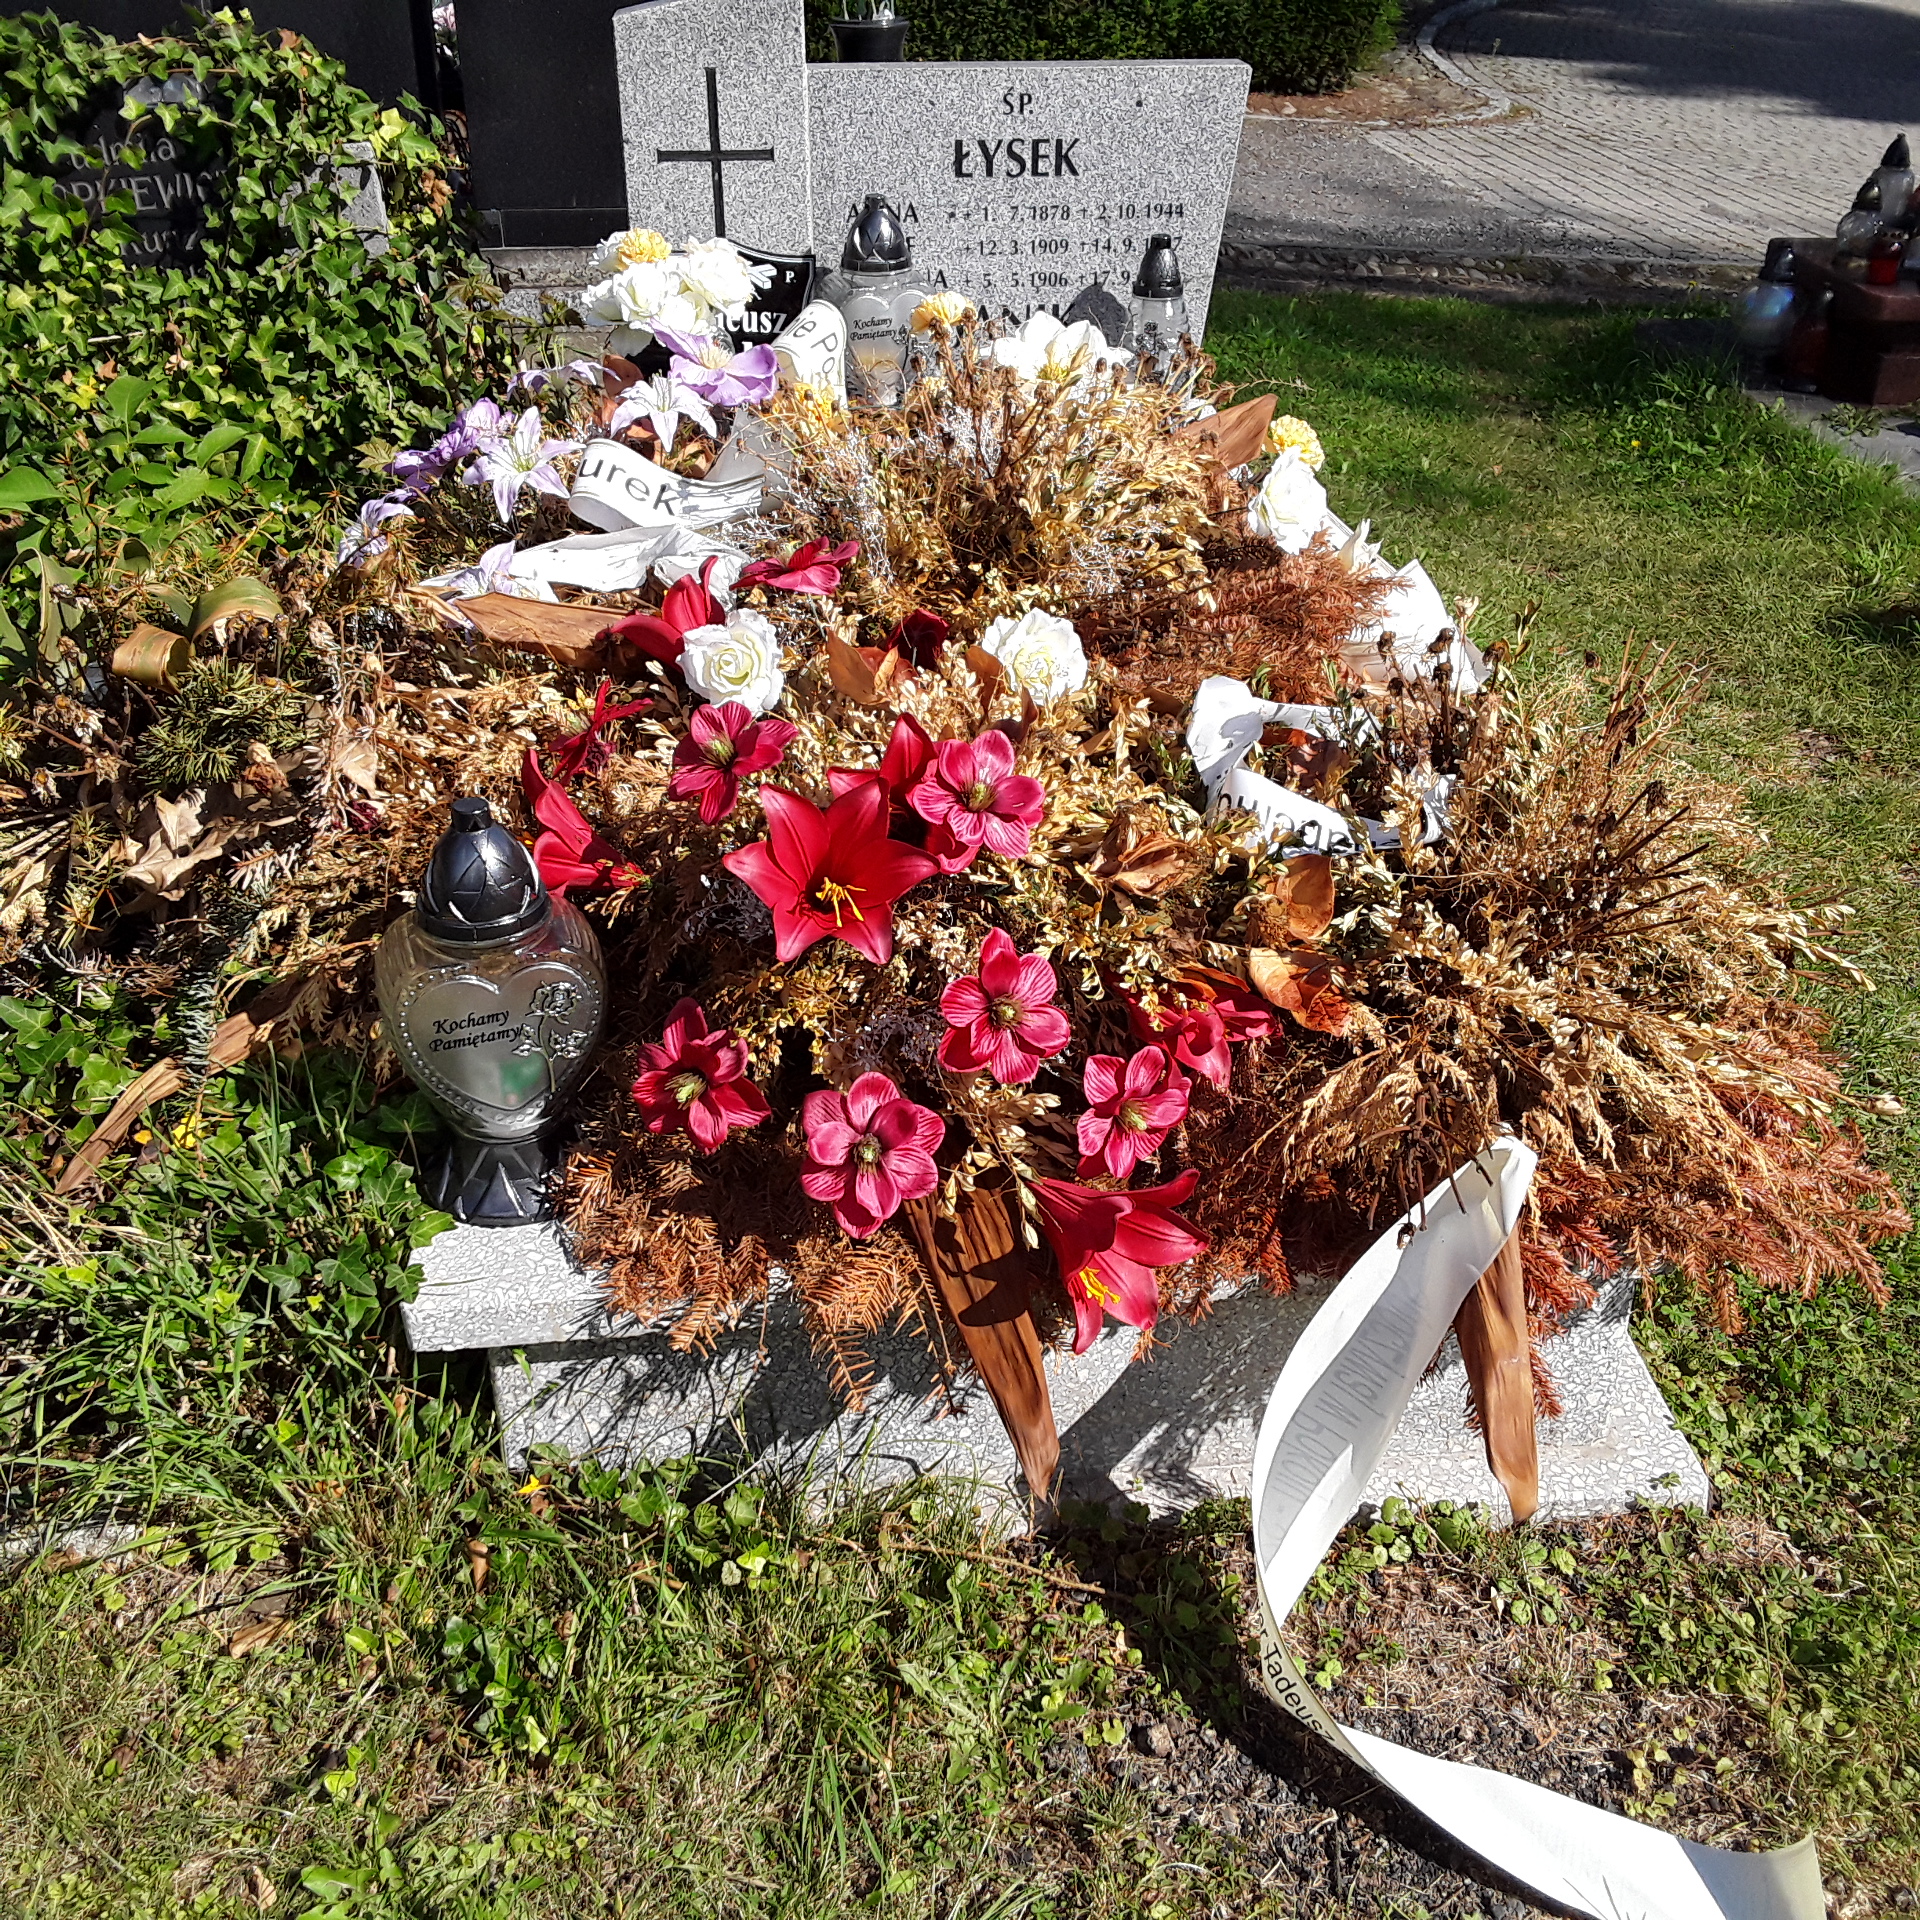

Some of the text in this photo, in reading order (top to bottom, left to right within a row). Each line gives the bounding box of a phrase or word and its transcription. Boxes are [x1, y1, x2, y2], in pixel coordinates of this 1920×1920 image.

[1003, 87, 1034, 116] ŚP.
[953, 137, 1081, 179] ŁYSEK
[846, 201, 919, 224] ANA
[850, 329, 898, 342] Pamiętamy
[853, 317, 893, 330] Kochamy
[432, 1009, 509, 1035] Kochamy
[428, 1024, 524, 1052] Pamiętamy
[1264, 1641, 1336, 1742] Tadeusz
